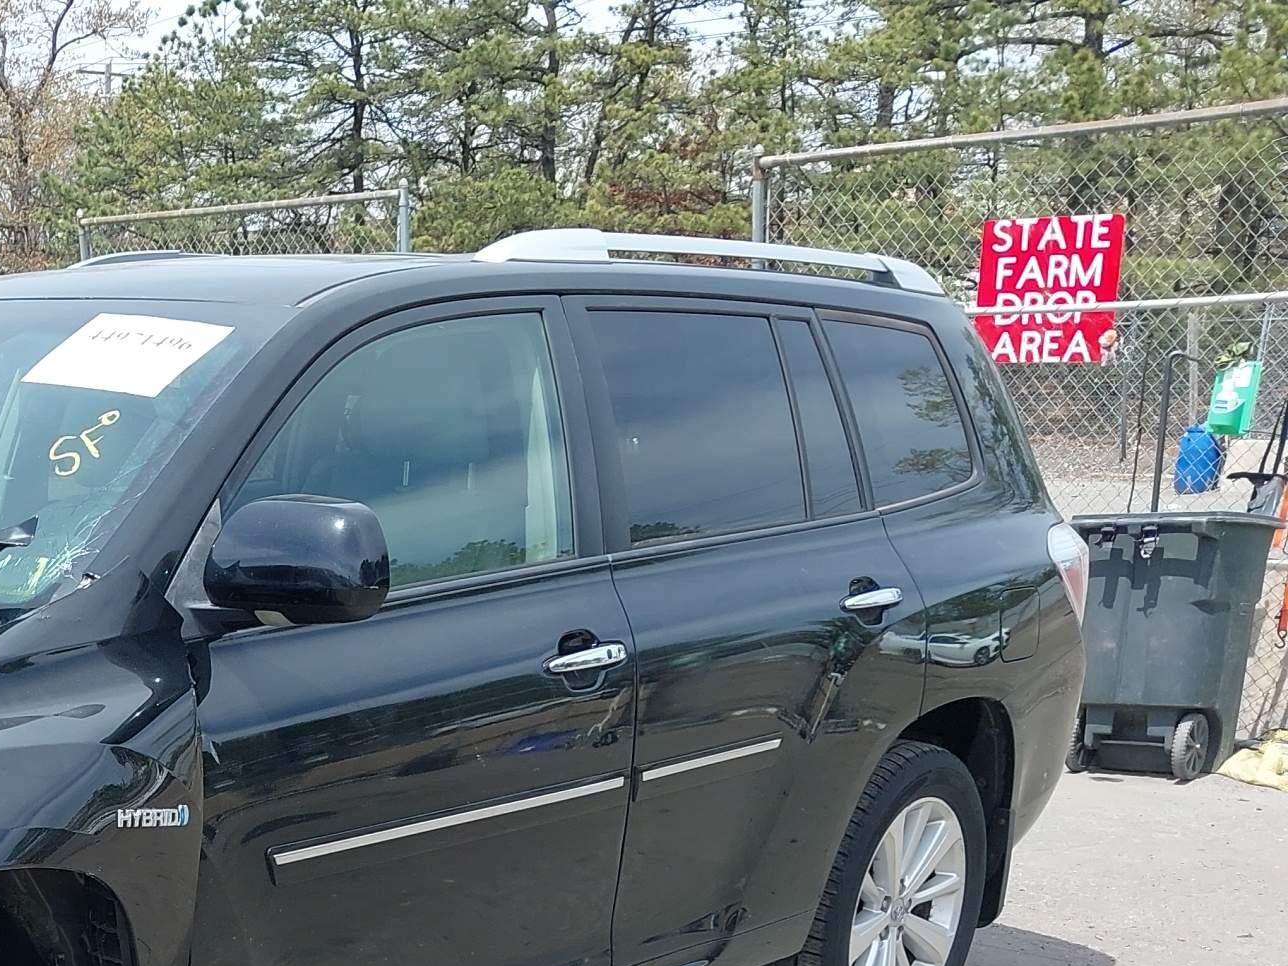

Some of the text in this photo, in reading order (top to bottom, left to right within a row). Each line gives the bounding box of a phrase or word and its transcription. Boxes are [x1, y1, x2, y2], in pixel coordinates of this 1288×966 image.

[992, 213, 1112, 252] STATE
[995, 253, 1104, 290] FARM
[993, 291, 1097, 326] DROP
[992, 329, 1092, 364] AREA
[117, 808, 181, 828] HYBRID
